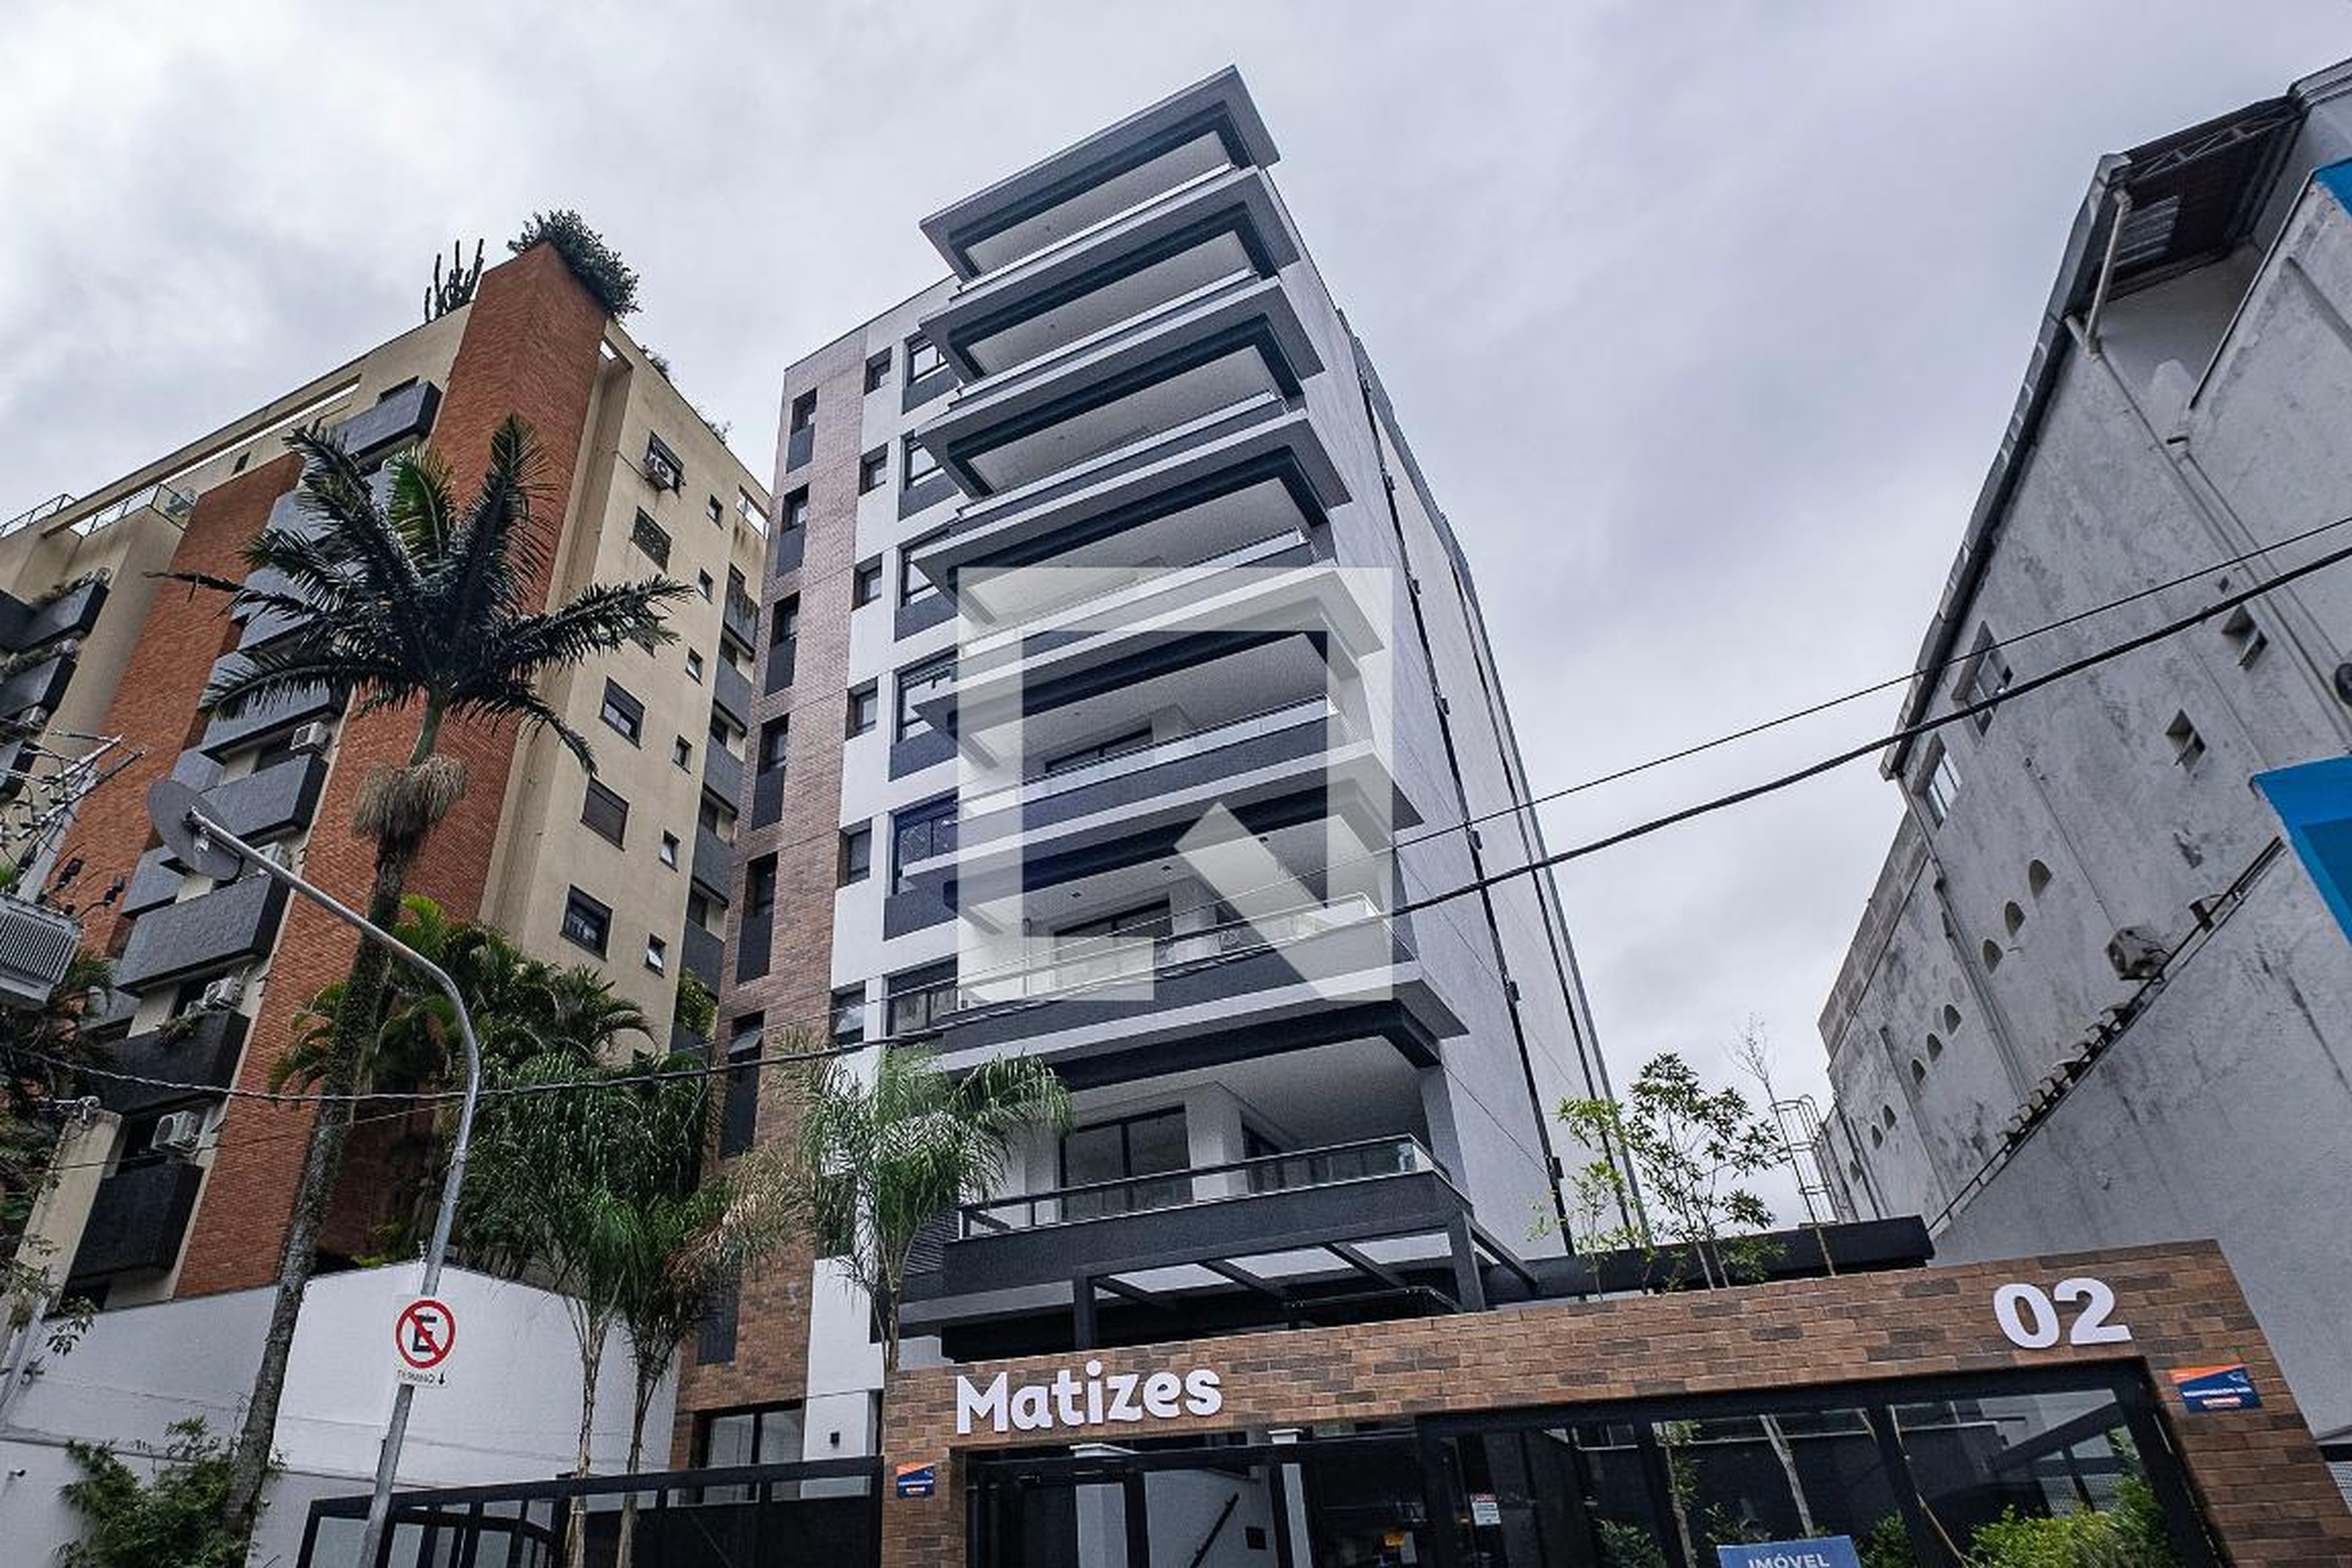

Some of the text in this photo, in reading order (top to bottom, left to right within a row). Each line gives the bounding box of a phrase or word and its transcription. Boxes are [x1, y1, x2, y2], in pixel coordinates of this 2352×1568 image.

[412, 1315, 437, 1351] E
[1994, 1277, 2132, 1348] 02
[956, 1360, 1223, 1434] Matizes
[1748, 1553, 1830, 1568] IMÓVEL
